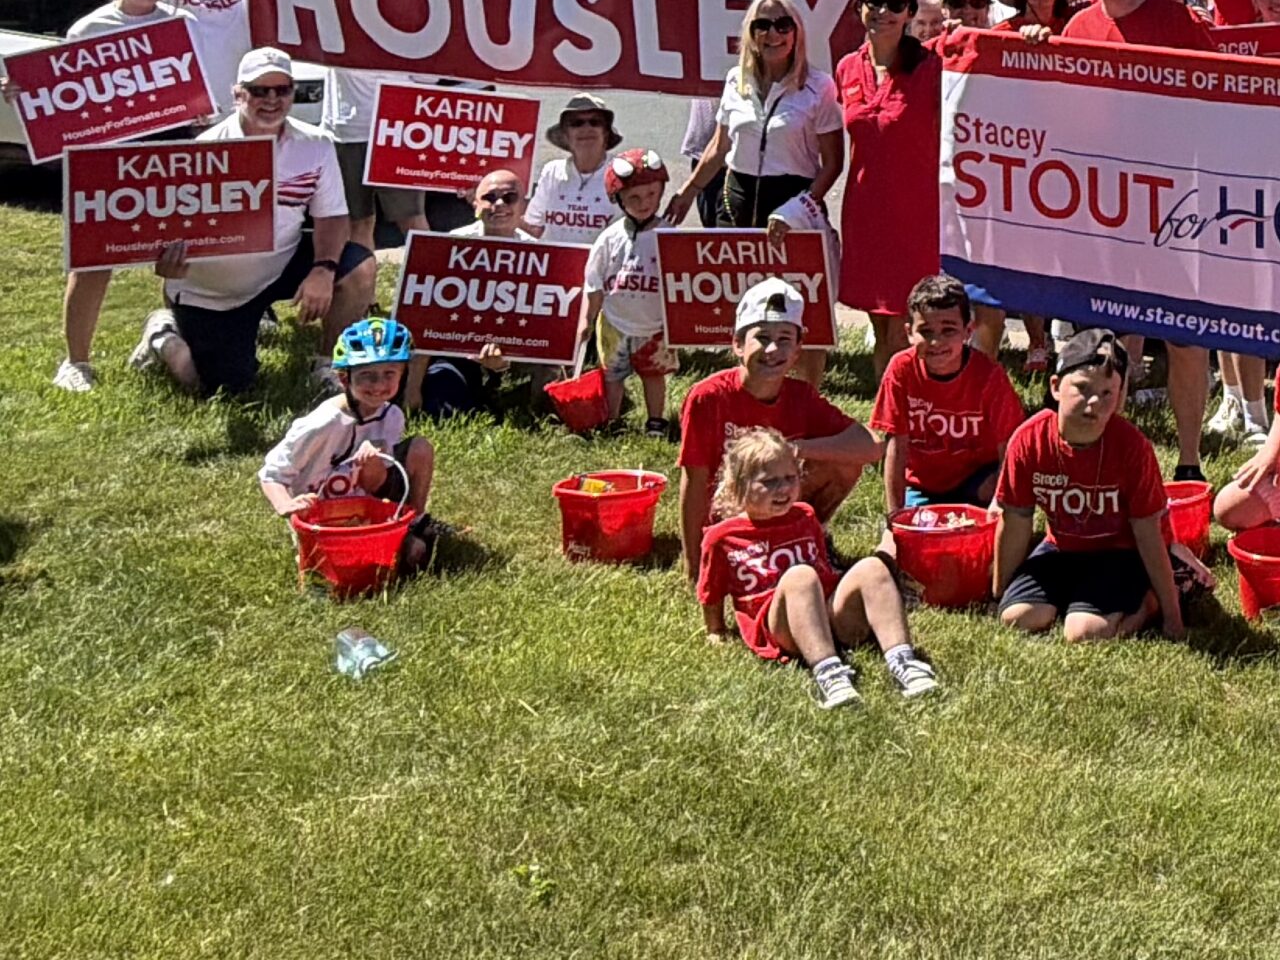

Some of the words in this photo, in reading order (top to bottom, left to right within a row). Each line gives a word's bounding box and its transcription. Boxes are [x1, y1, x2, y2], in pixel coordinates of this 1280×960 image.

[49, 33, 153, 77] KARIN
[1217, 40, 1259, 57] acey
[20, 51, 194, 121] HOUSLEY
[1001, 50, 1115, 79] MINNESOTA
[1119, 63, 1187, 88] HOUSE
[1192, 72, 1219, 92] OF
[62, 104, 187, 141] HousleyForSenate.com
[414, 95, 504, 124] KARIN
[376, 119, 534, 159] HOUSLEY
[953, 112, 1047, 158] Stacey
[117, 150, 229, 181] KARIN
[74, 179, 271, 224] HOUSLEY
[567, 204, 589, 213] TEAM
[953, 150, 1175, 234] STOUT
[1153, 188, 1213, 248] for
[545, 211, 613, 229] HOUSLEY
[448, 246, 550, 277] KARIN
[696, 241, 788, 265] KARIN
[402, 274, 583, 317] HOUSLEY
[603, 274, 659, 293] OUSLE
[423, 328, 549, 348] HousleyForSenate.com
[1032, 472, 1069, 487] Stacey
[1033, 489, 1120, 515] STOUT
